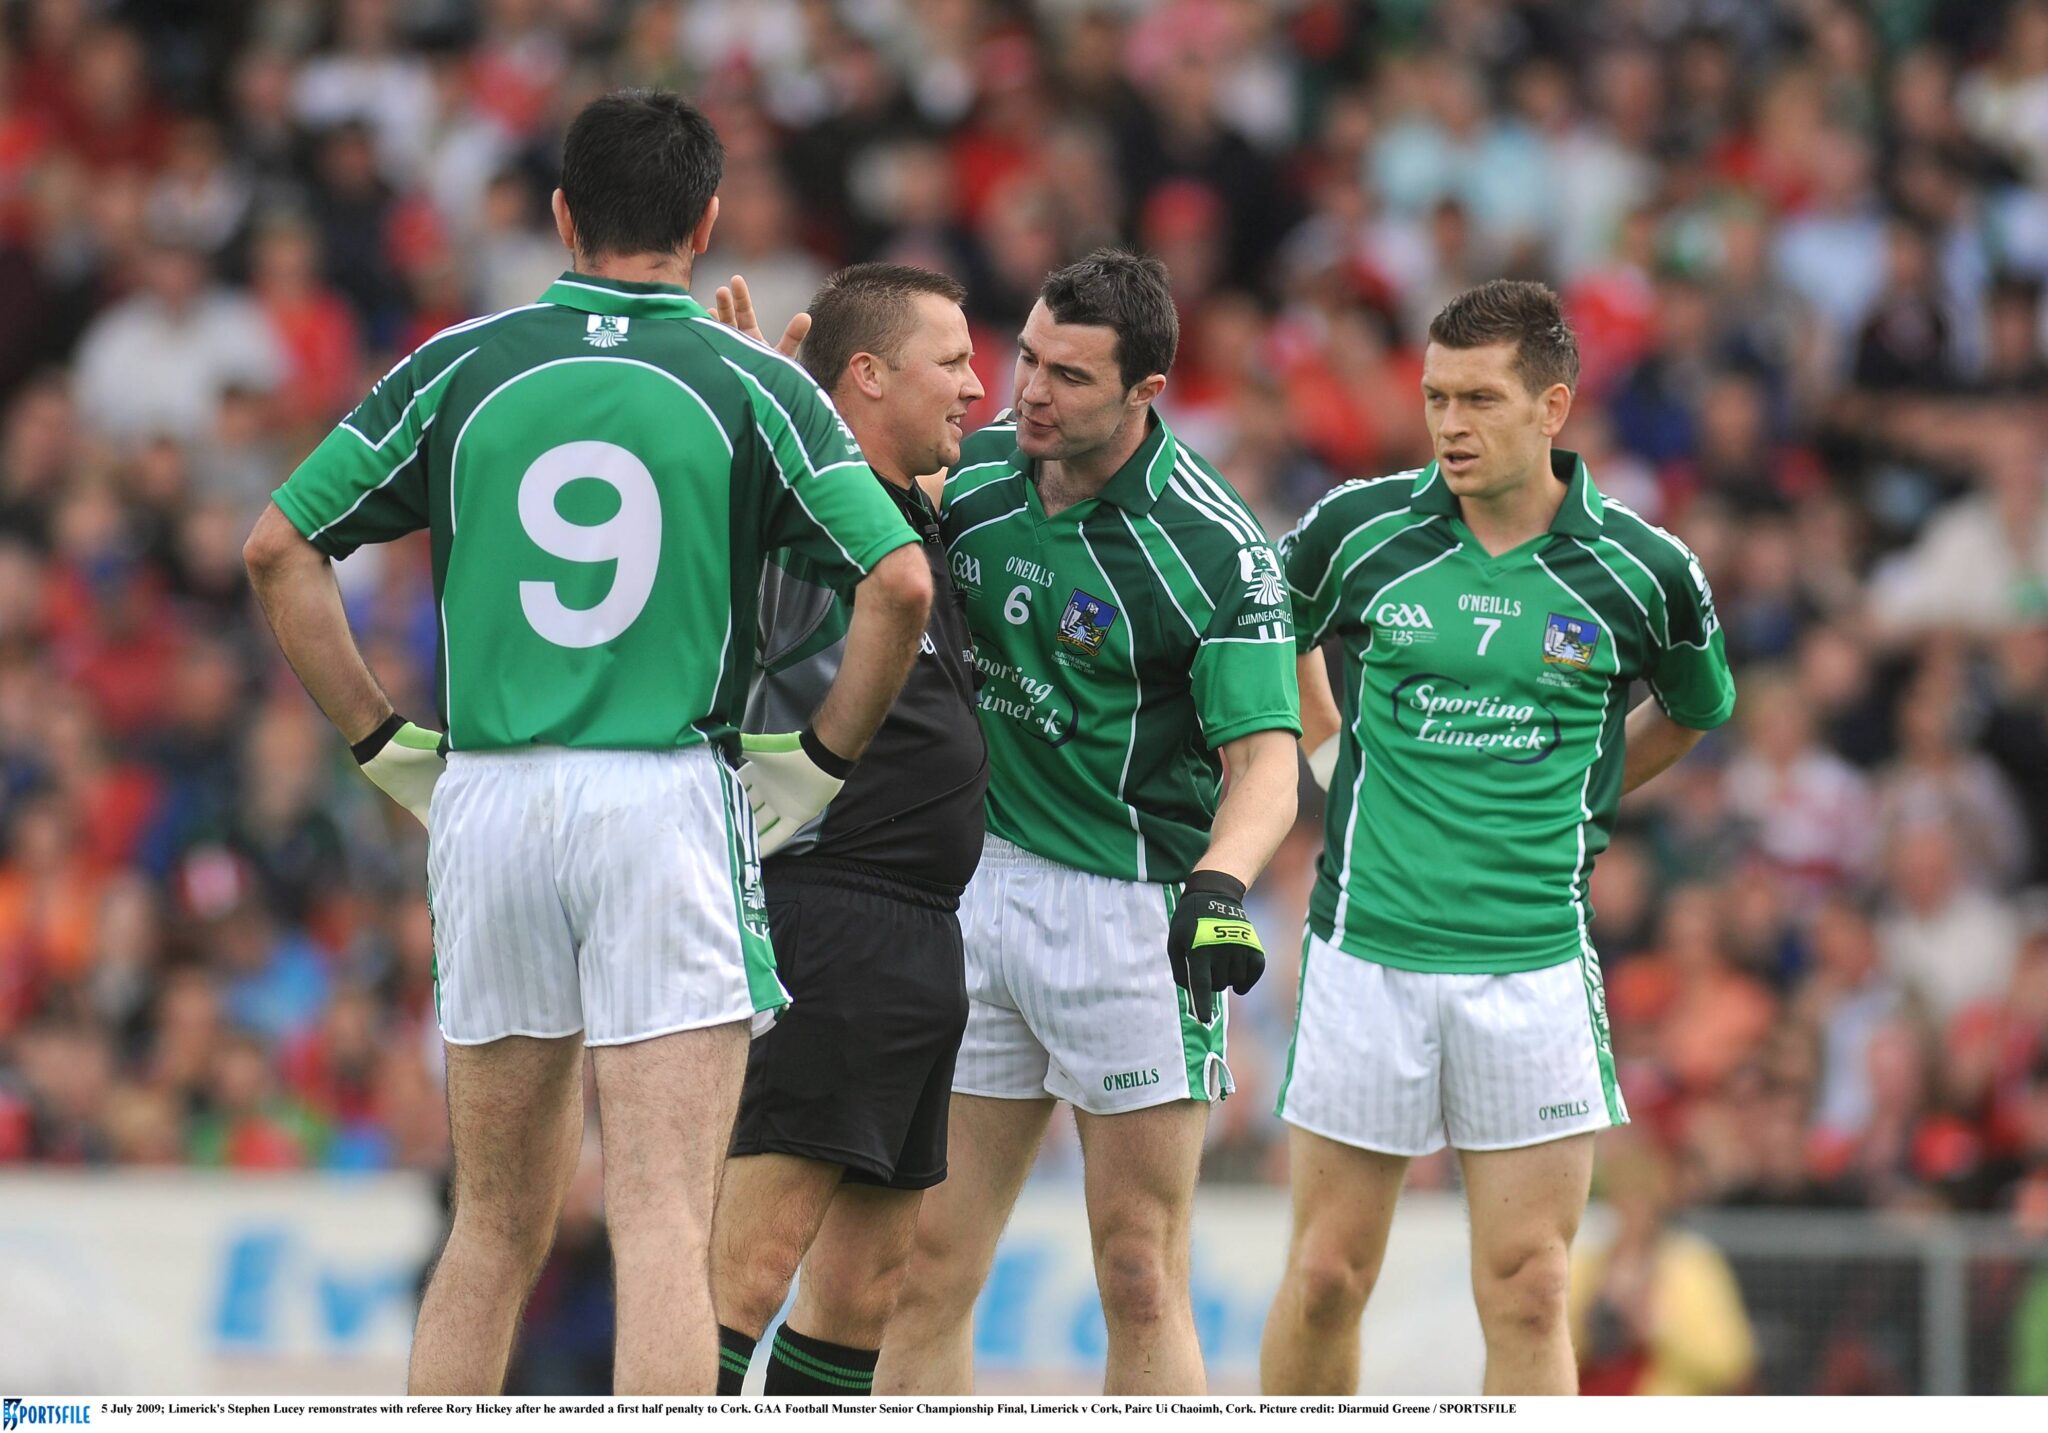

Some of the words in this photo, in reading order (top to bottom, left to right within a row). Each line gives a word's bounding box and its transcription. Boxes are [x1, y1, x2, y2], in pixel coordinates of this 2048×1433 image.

[517, 440, 663, 649] 9
[953, 551, 981, 586] GAA
[1005, 556, 1055, 588] O'NEILLS
[1004, 585, 1032, 625] 6
[1376, 603, 1434, 629] GAA
[1458, 593, 1522, 617] O'NEILLS
[1391, 630, 1414, 646] 125
[1473, 617, 1502, 656] 7
[1409, 684, 1534, 724] Sporting
[1415, 718, 1546, 750] Limerick
[1103, 1068, 1160, 1092] O'NEILLS
[1538, 1100, 1590, 1120] O'NEILLS
